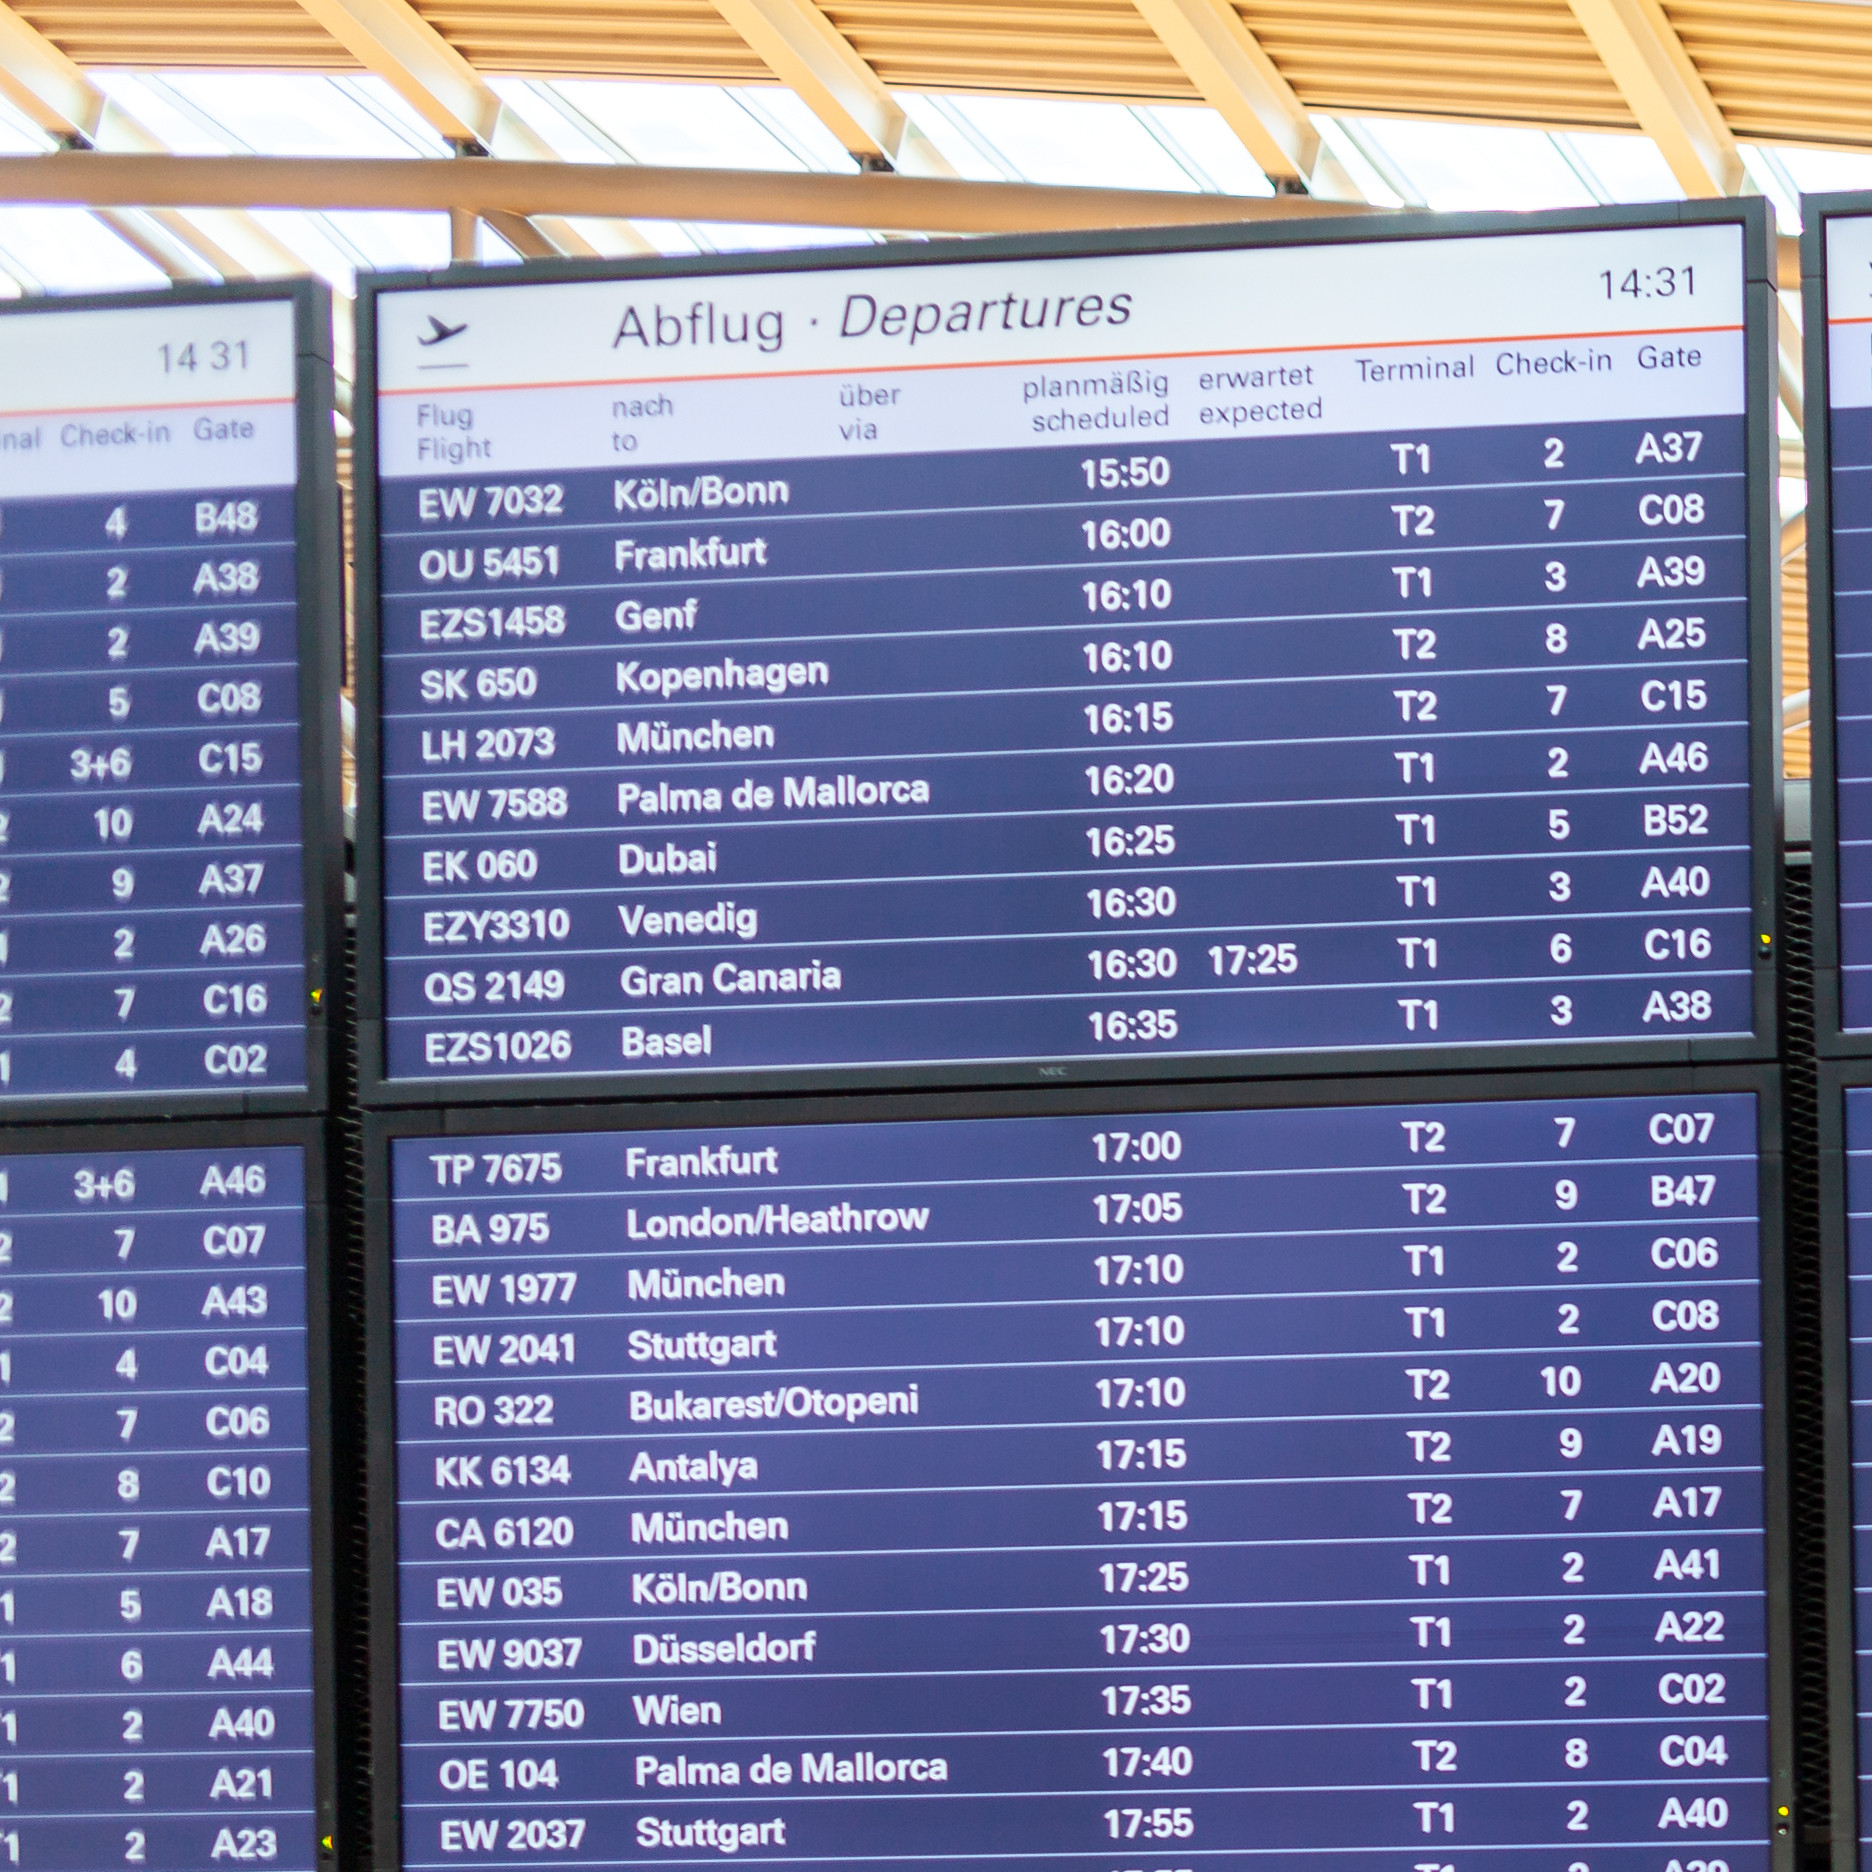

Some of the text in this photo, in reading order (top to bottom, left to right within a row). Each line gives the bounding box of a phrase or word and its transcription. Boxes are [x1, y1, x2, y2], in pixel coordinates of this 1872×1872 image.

[419, 431, 1703, 519] EW 7032 Köln/Bonn 15:50 T1 2 A37
[74, 1165, 266, 1199] 3+6 A46
[435, 1424, 1722, 1487] KK 6134 Antalya 17:15 T2 9 A19
